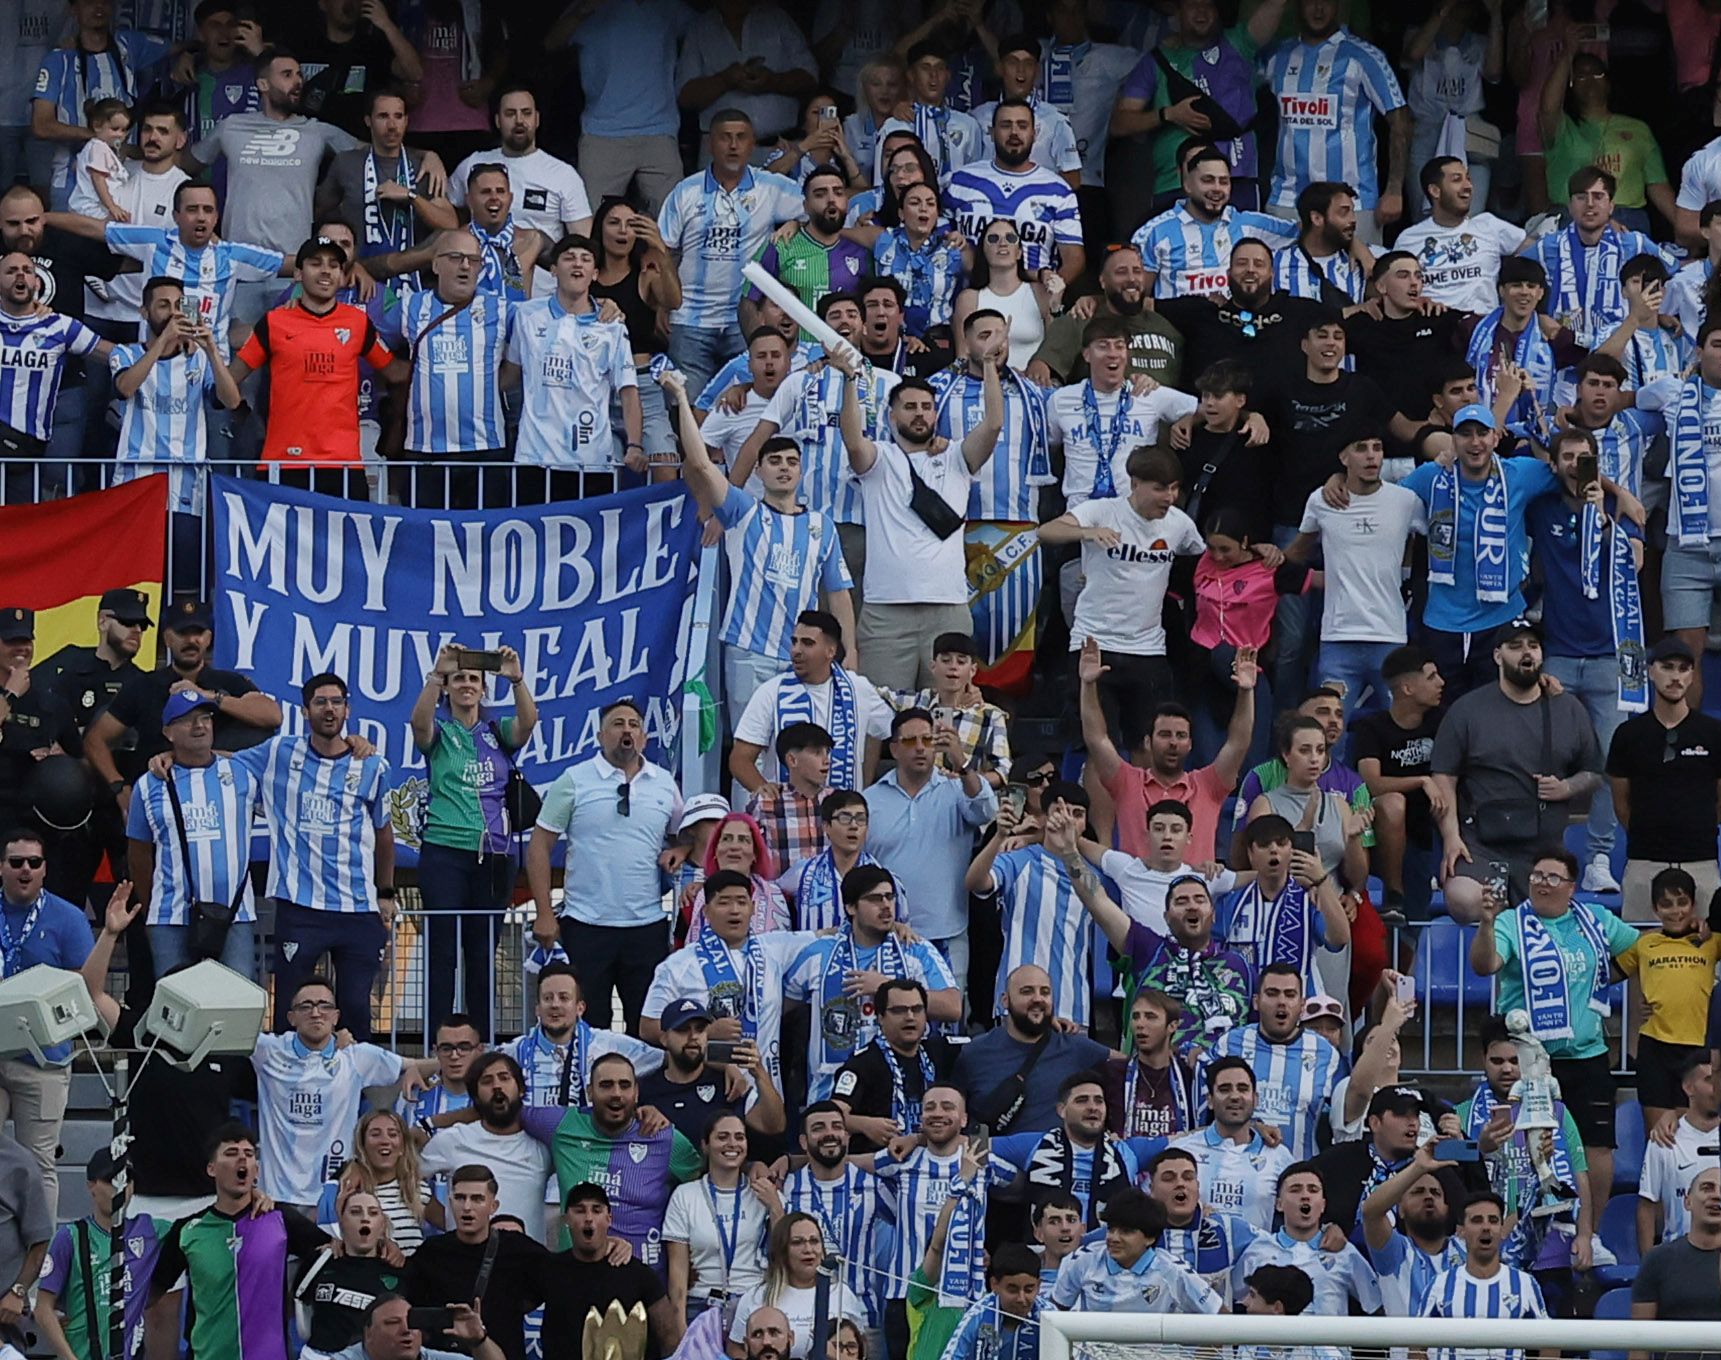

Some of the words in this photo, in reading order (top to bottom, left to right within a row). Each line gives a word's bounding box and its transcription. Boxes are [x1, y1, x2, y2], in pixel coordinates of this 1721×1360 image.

[1280, 95, 1330, 116] Tivoli
[1450, 267, 1482, 283] OVER
[579, 410, 594, 445] Olin
[224, 492, 403, 612] MUY
[428, 492, 688, 616] NOBLE
[1107, 544, 1176, 565] ellesse
[227, 590, 269, 671] Y
[1648, 955, 1707, 968] MARATHON
[291, 1090, 323, 1105] má
[290, 1100, 323, 1120] laga
